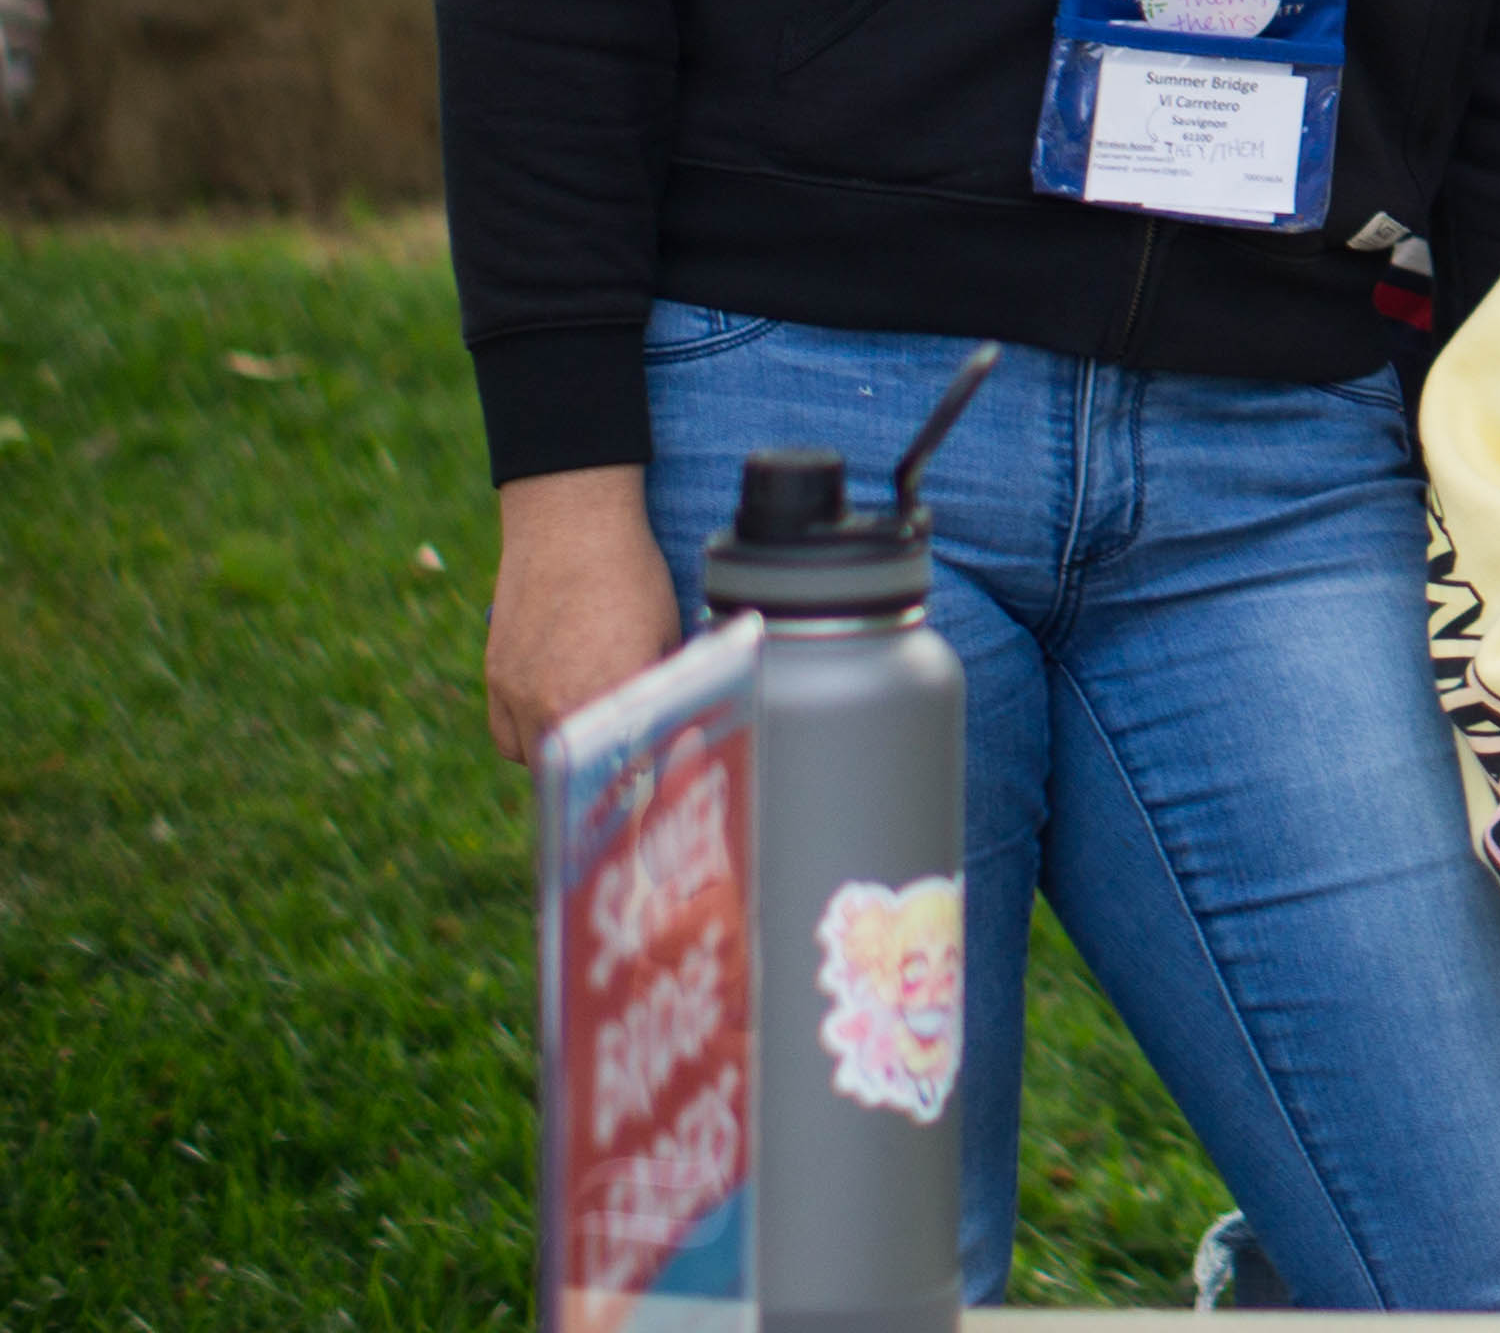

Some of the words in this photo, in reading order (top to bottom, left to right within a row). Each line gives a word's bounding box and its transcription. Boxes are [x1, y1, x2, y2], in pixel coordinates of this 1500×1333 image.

[1168, 11, 1257, 32] theirs
[1146, 71, 1208, 89] Summer
[1211, 76, 1258, 94] Bridge
[1176, 96, 1241, 112] Carretero
